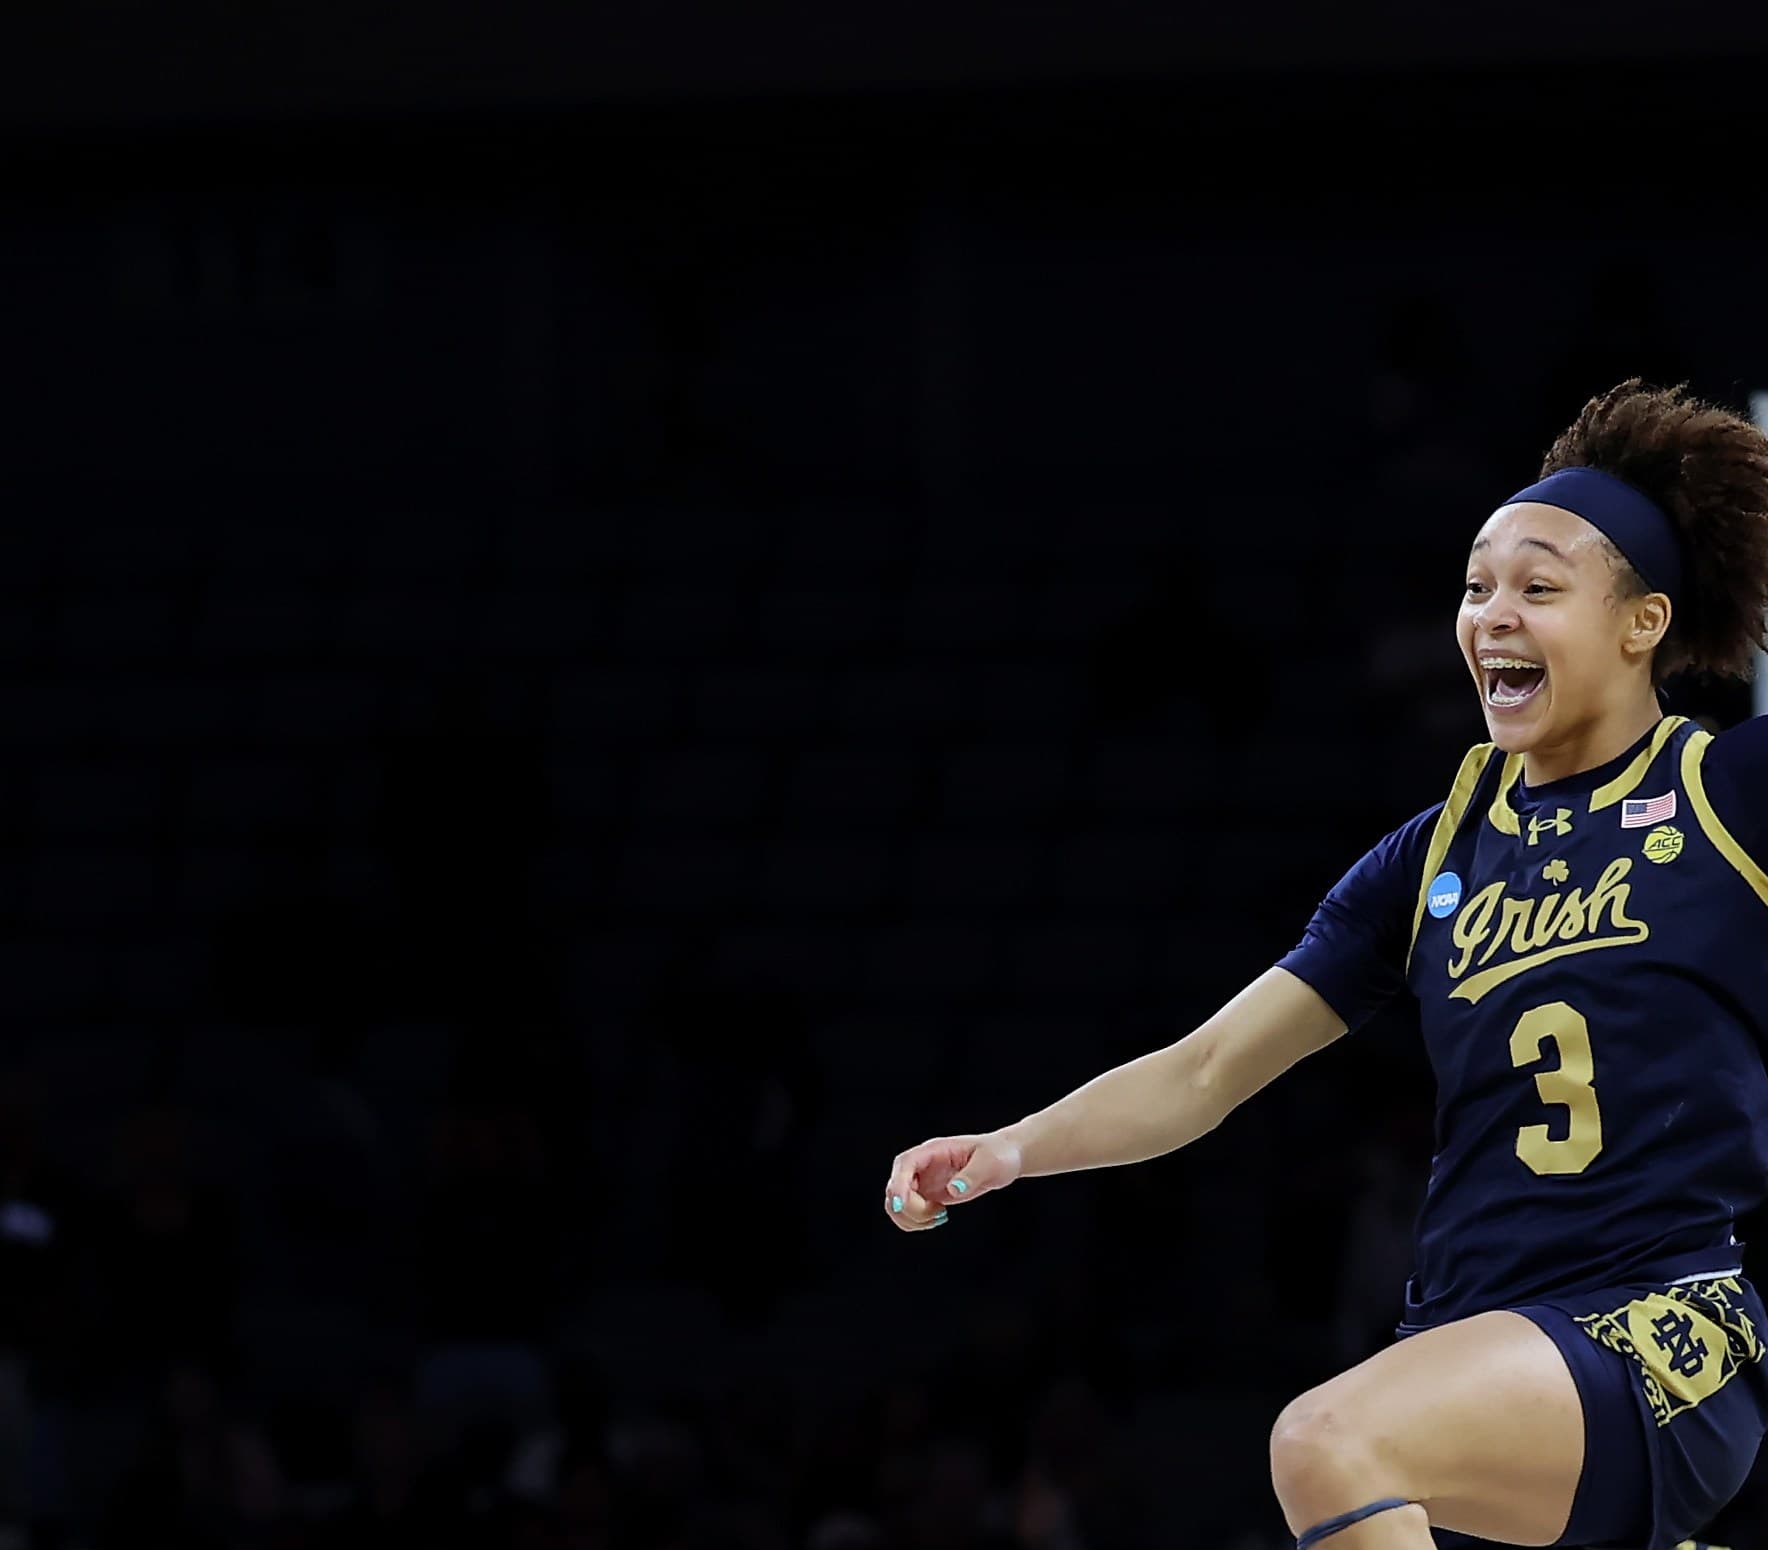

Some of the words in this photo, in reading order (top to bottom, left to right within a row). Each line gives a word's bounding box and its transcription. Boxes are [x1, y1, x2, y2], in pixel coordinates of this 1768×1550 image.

[1651, 835, 1681, 850] ACC
[1448, 857, 1649, 978] Irish
[1508, 1001, 1603, 1175] 3
